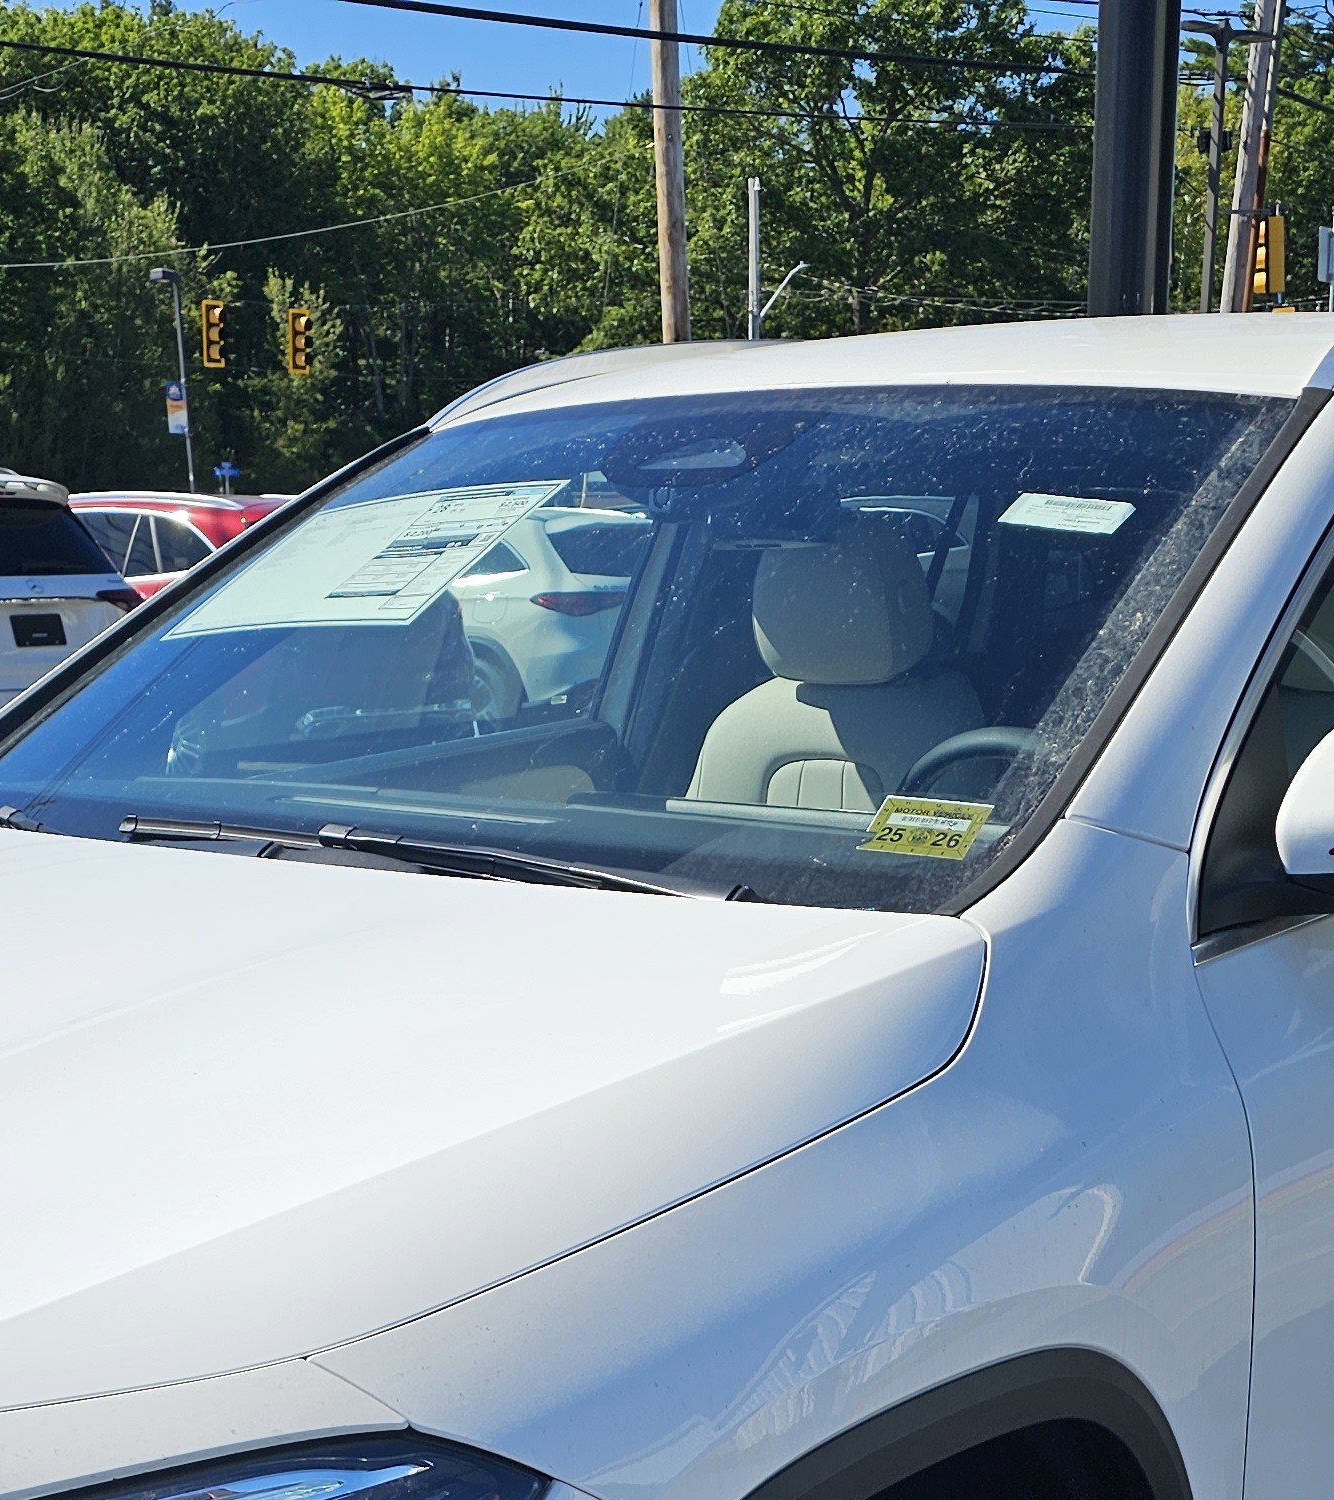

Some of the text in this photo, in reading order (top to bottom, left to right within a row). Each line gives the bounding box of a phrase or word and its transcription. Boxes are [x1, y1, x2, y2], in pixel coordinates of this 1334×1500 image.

[894, 807, 930, 816] MOTOR
[875, 827, 907, 843] 25
[930, 832, 963, 849] 26
